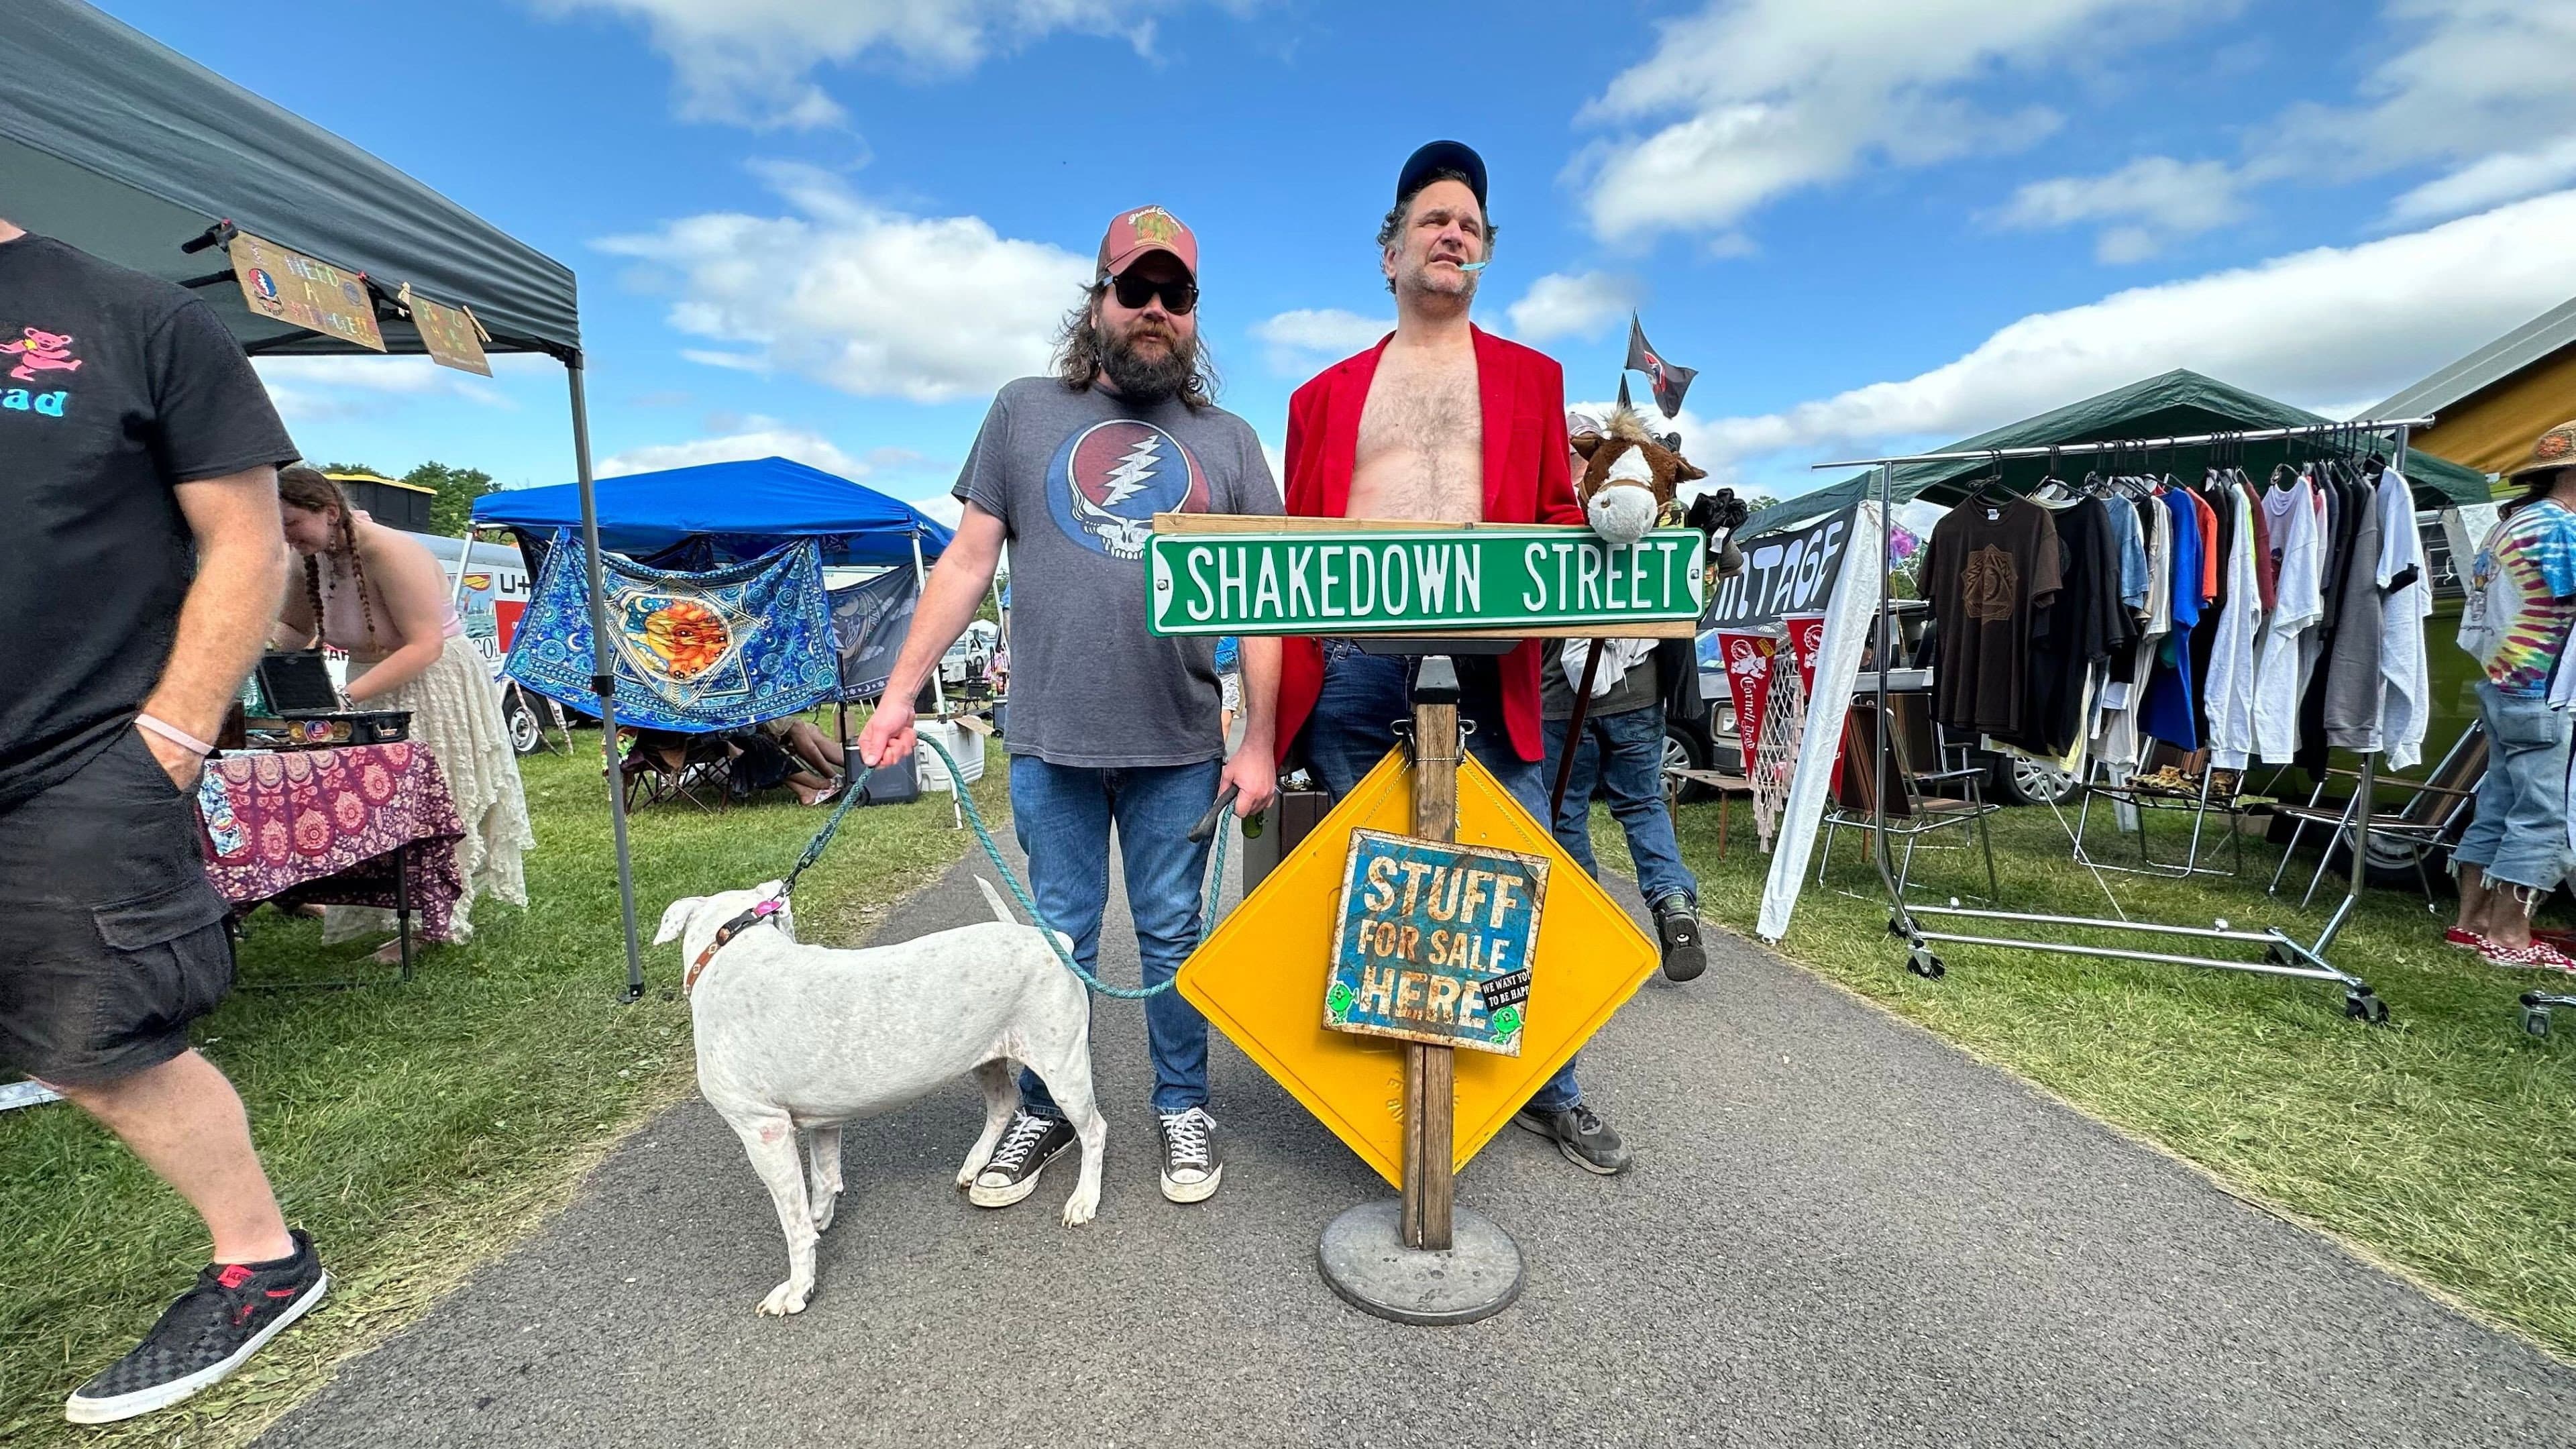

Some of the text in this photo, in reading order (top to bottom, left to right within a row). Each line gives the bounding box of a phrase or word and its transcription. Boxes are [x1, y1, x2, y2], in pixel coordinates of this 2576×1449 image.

[304, 281, 320, 303] A
[0, 388, 68, 417] ad
[1186, 541, 1678, 622] SHAKEDOWN STREET
[1701, 520, 1844, 622] INTAGE
[1739, 676, 1756, 722] Cornell
[1364, 856, 1523, 928] STUFF
[1357, 919, 1509, 973] FOR SALE
[1358, 965, 1487, 1029] HERE
[1483, 981, 1495, 994] WE
[1495, 975, 1516, 990] WANT
[1488, 996, 1499, 1007] TO
[1499, 991, 1510, 1004] BE
